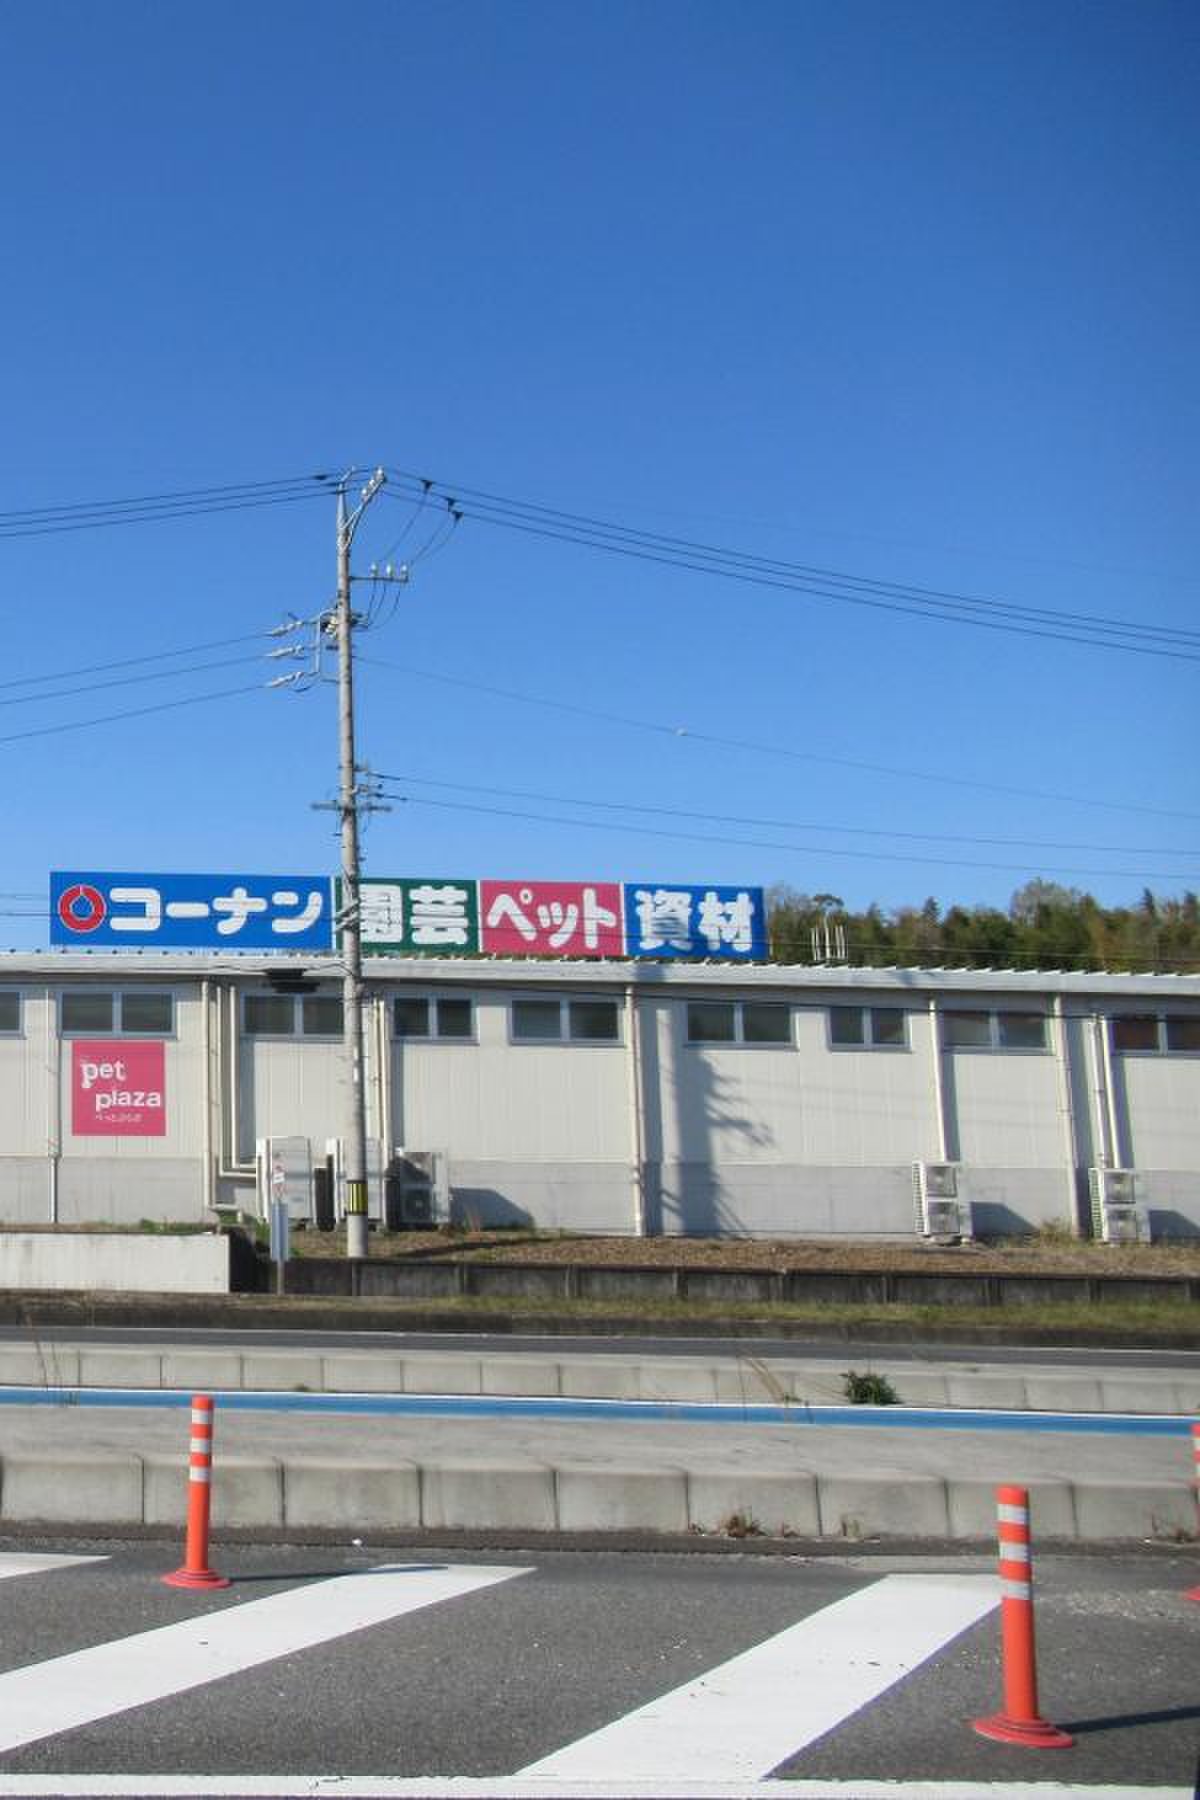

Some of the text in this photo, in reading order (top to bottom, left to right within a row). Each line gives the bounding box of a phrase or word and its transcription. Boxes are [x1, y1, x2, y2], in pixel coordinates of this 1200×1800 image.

[109, 887, 323, 935] コーナン
[487, 888, 617, 949] ペット
[634, 889, 755, 951] 資材
[80, 1060, 127, 1089] pet
[95, 1089, 161, 1112] plaza
